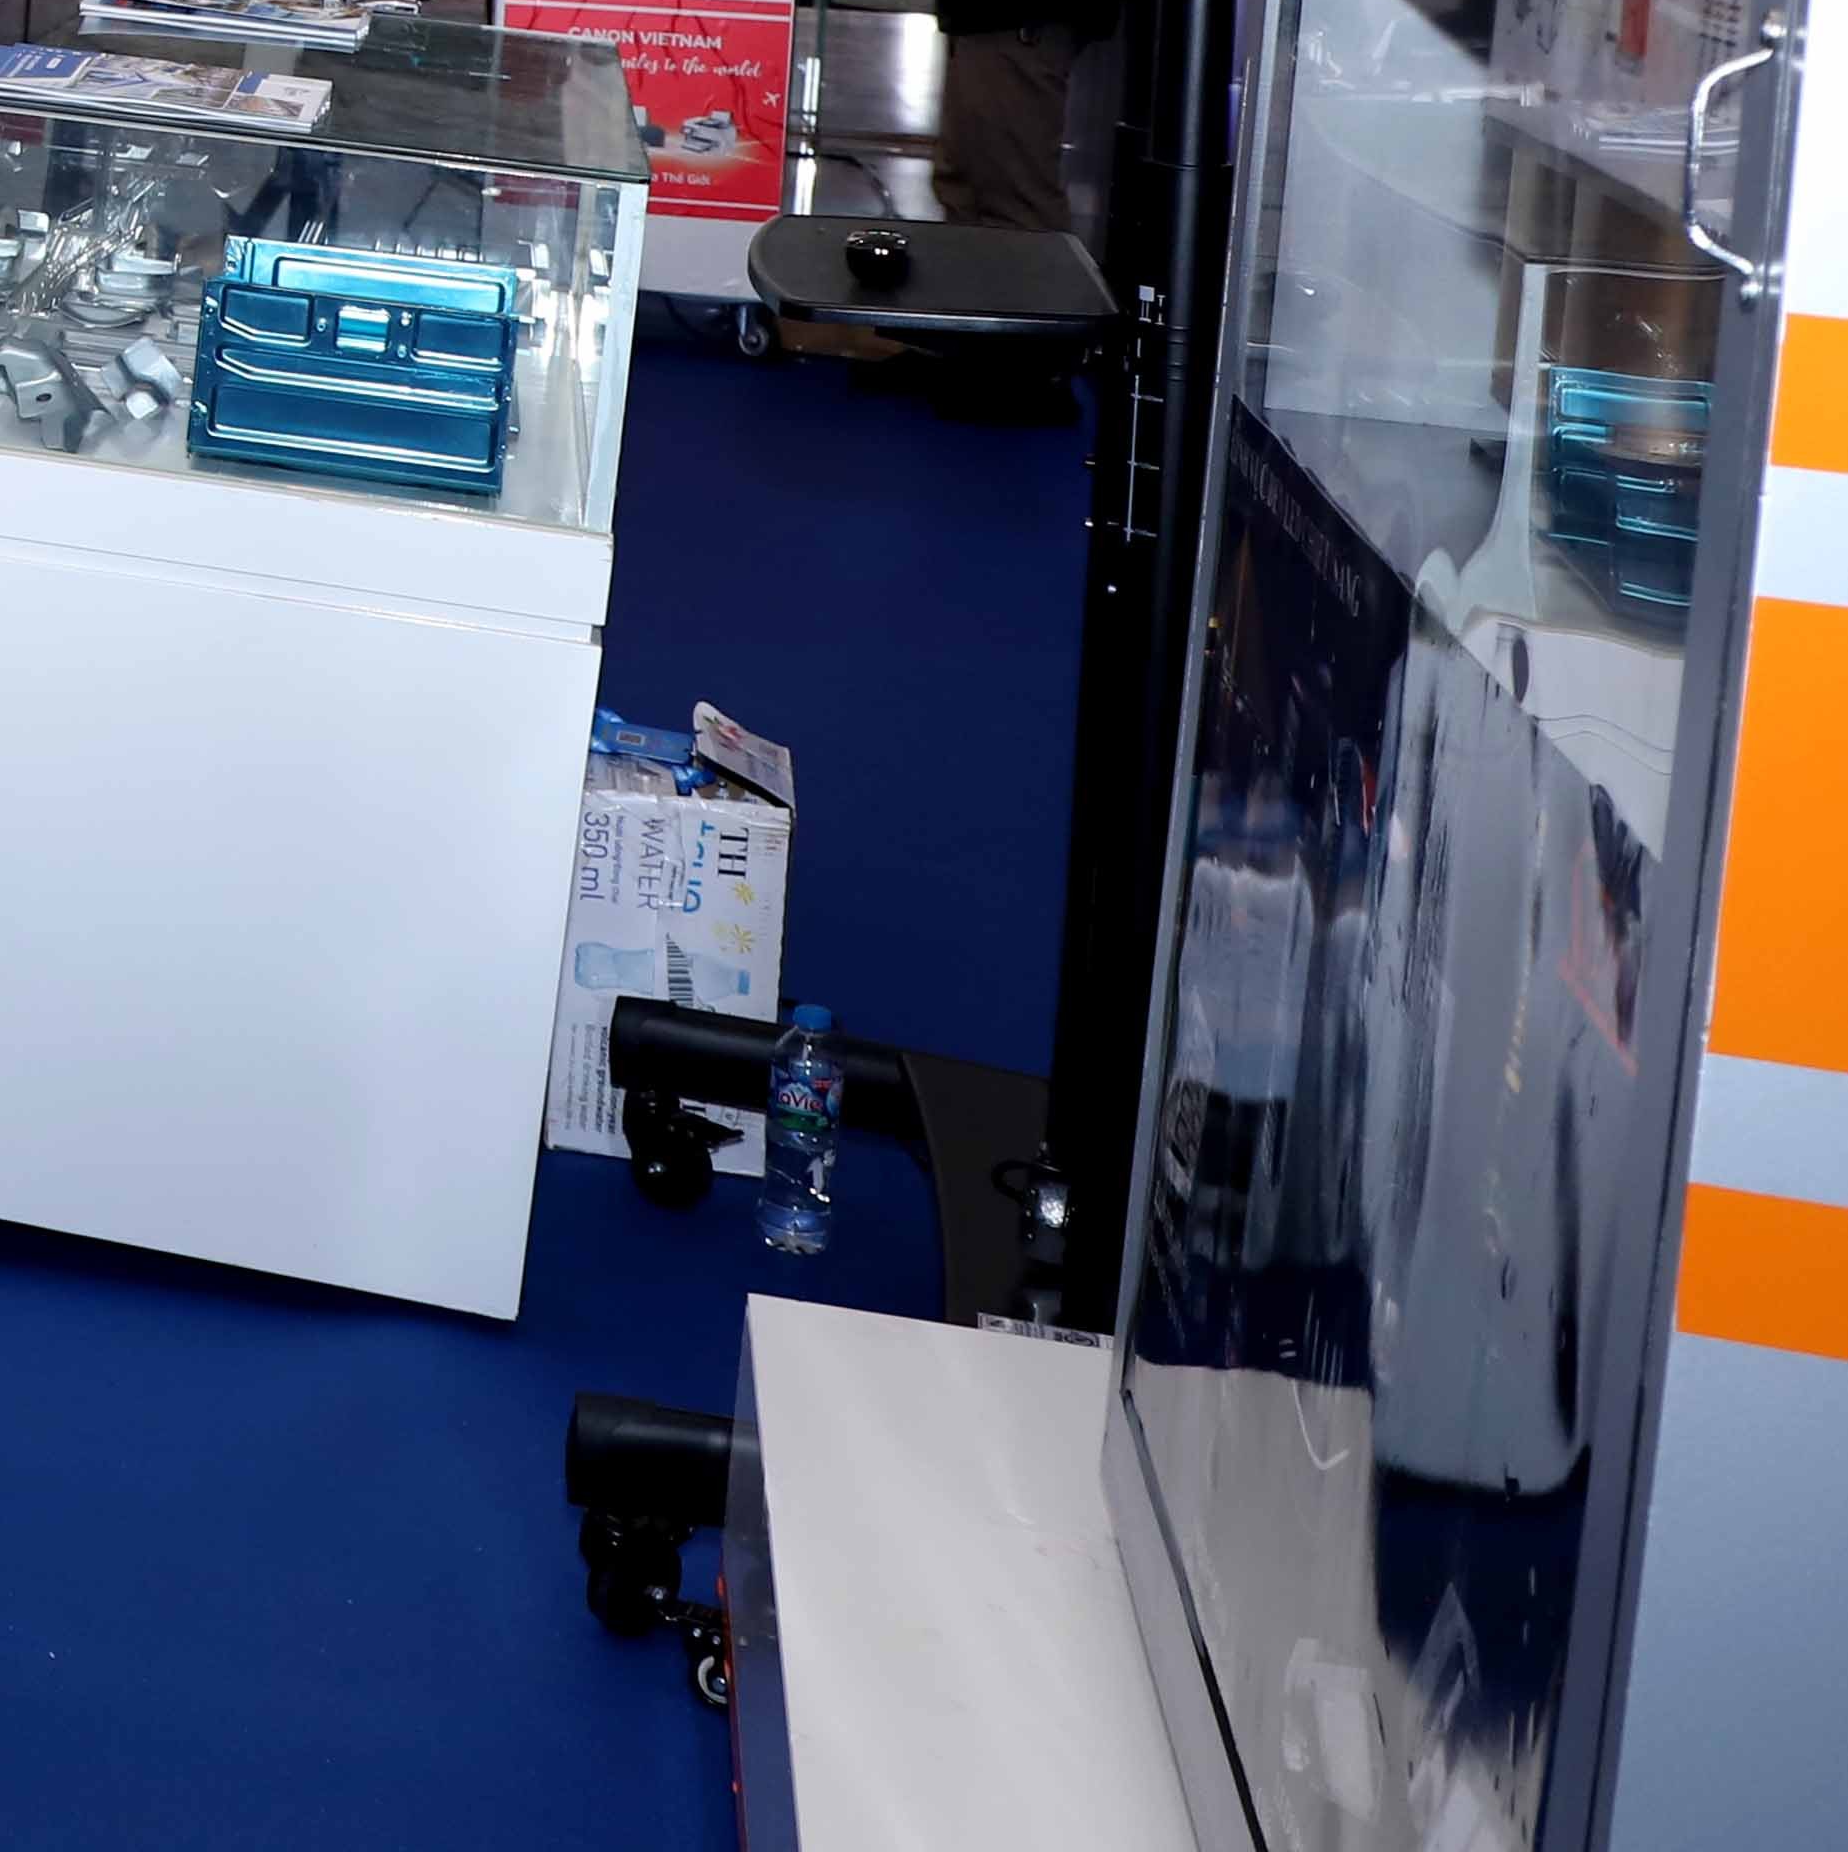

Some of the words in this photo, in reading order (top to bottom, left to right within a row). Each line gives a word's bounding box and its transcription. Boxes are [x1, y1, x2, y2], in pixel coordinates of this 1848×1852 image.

[568, 26, 634, 45] CANON
[639, 30, 723, 50] VIETNAM
[682, 55, 707, 76] the
[713, 59, 762, 79] world
[583, 811, 610, 860] 350
[717, 827, 750, 879] TH
[580, 866, 606, 901] ml
[636, 817, 666, 910] WATER
